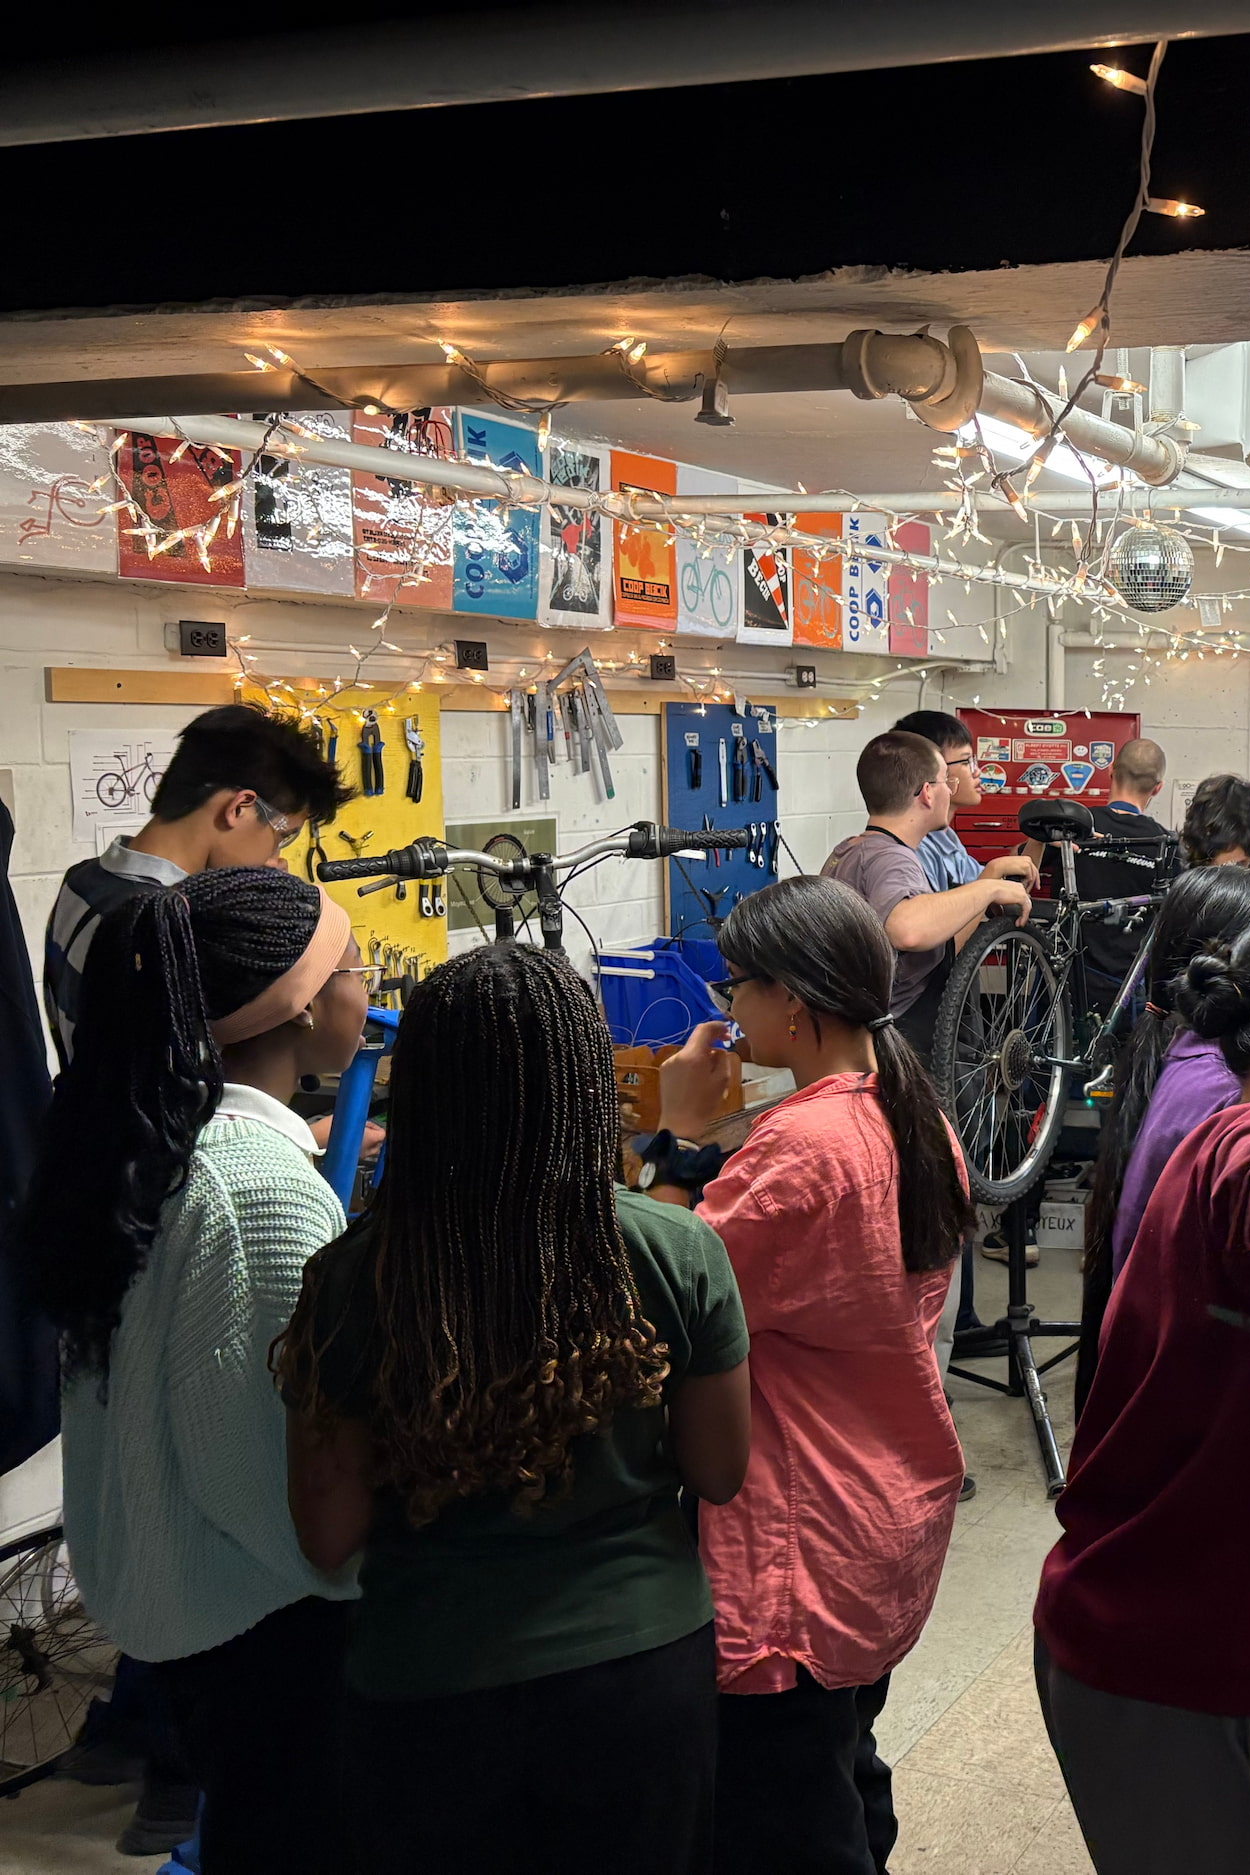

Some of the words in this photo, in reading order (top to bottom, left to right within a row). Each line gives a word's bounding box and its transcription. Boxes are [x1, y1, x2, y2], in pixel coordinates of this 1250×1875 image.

[137, 436, 171, 520] COOP
[623, 579, 644, 594] COOP
[849, 586, 860, 642] COOP
